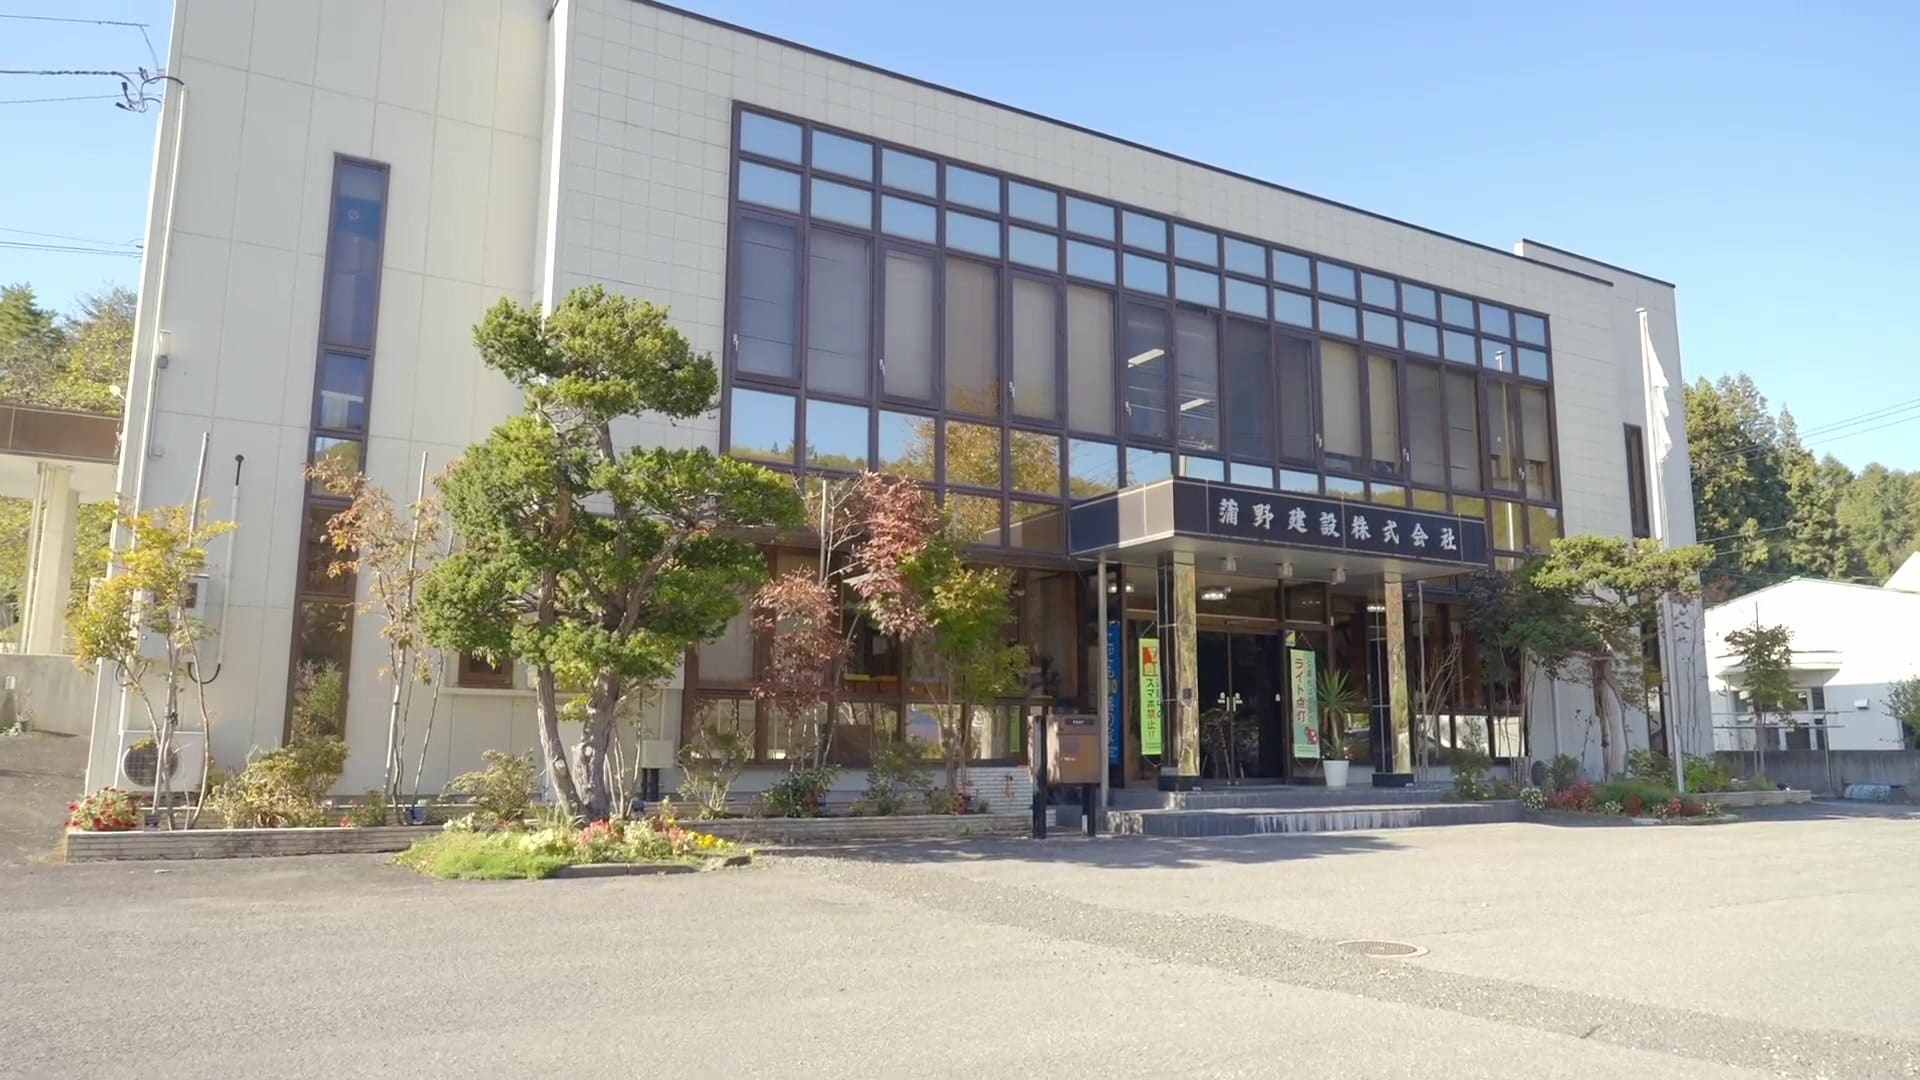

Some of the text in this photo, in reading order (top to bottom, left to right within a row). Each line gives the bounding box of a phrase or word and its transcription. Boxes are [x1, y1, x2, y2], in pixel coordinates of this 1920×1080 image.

[1218, 497, 1458, 551] 蒲野建設株式会社
[1295, 657, 1306, 723] ライト点灯
